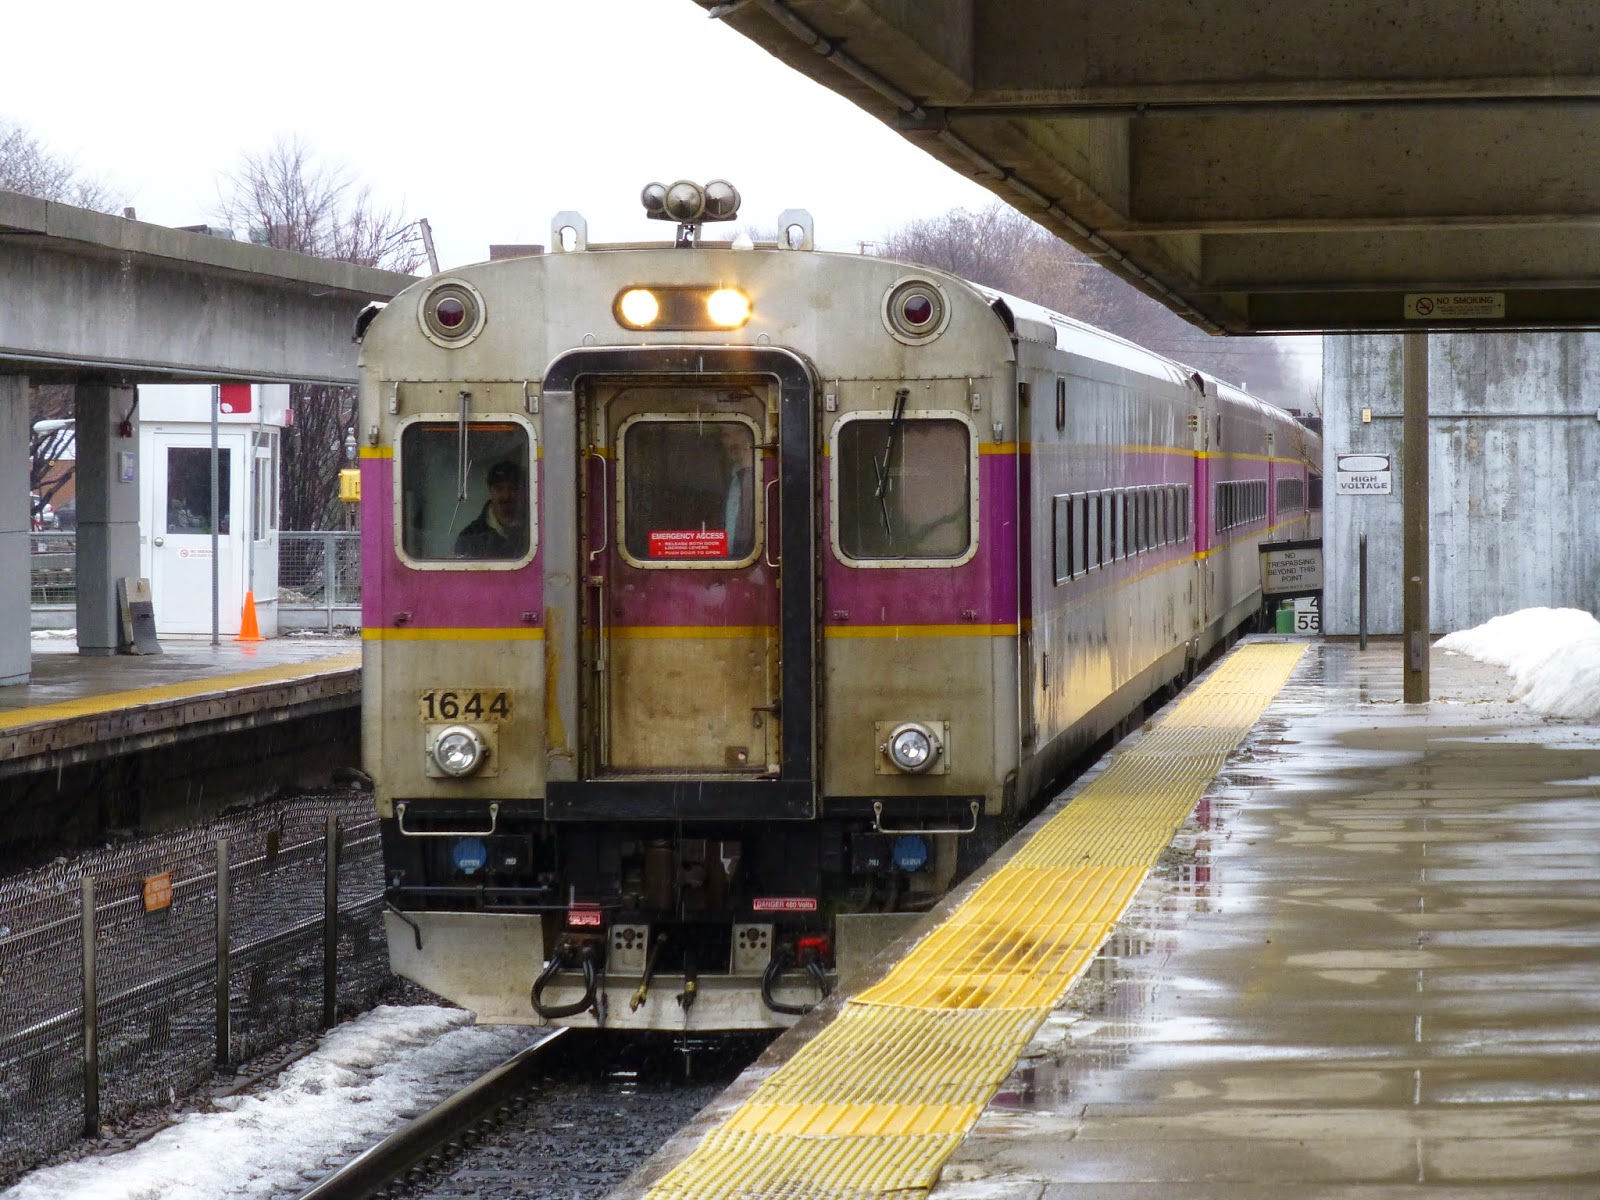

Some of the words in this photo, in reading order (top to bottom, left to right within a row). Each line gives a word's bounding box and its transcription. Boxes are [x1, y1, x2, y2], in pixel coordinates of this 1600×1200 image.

[1436, 297, 1450, 305] NO
[1453, 296, 1494, 304] SMOKING
[651, 532, 695, 540] EMERGENCY
[696, 532, 724, 540] ACCESS
[1267, 558, 1315, 568] TRESPASSING
[1267, 568, 1297, 576] BEYOND
[423, 692, 510, 719] 1644
